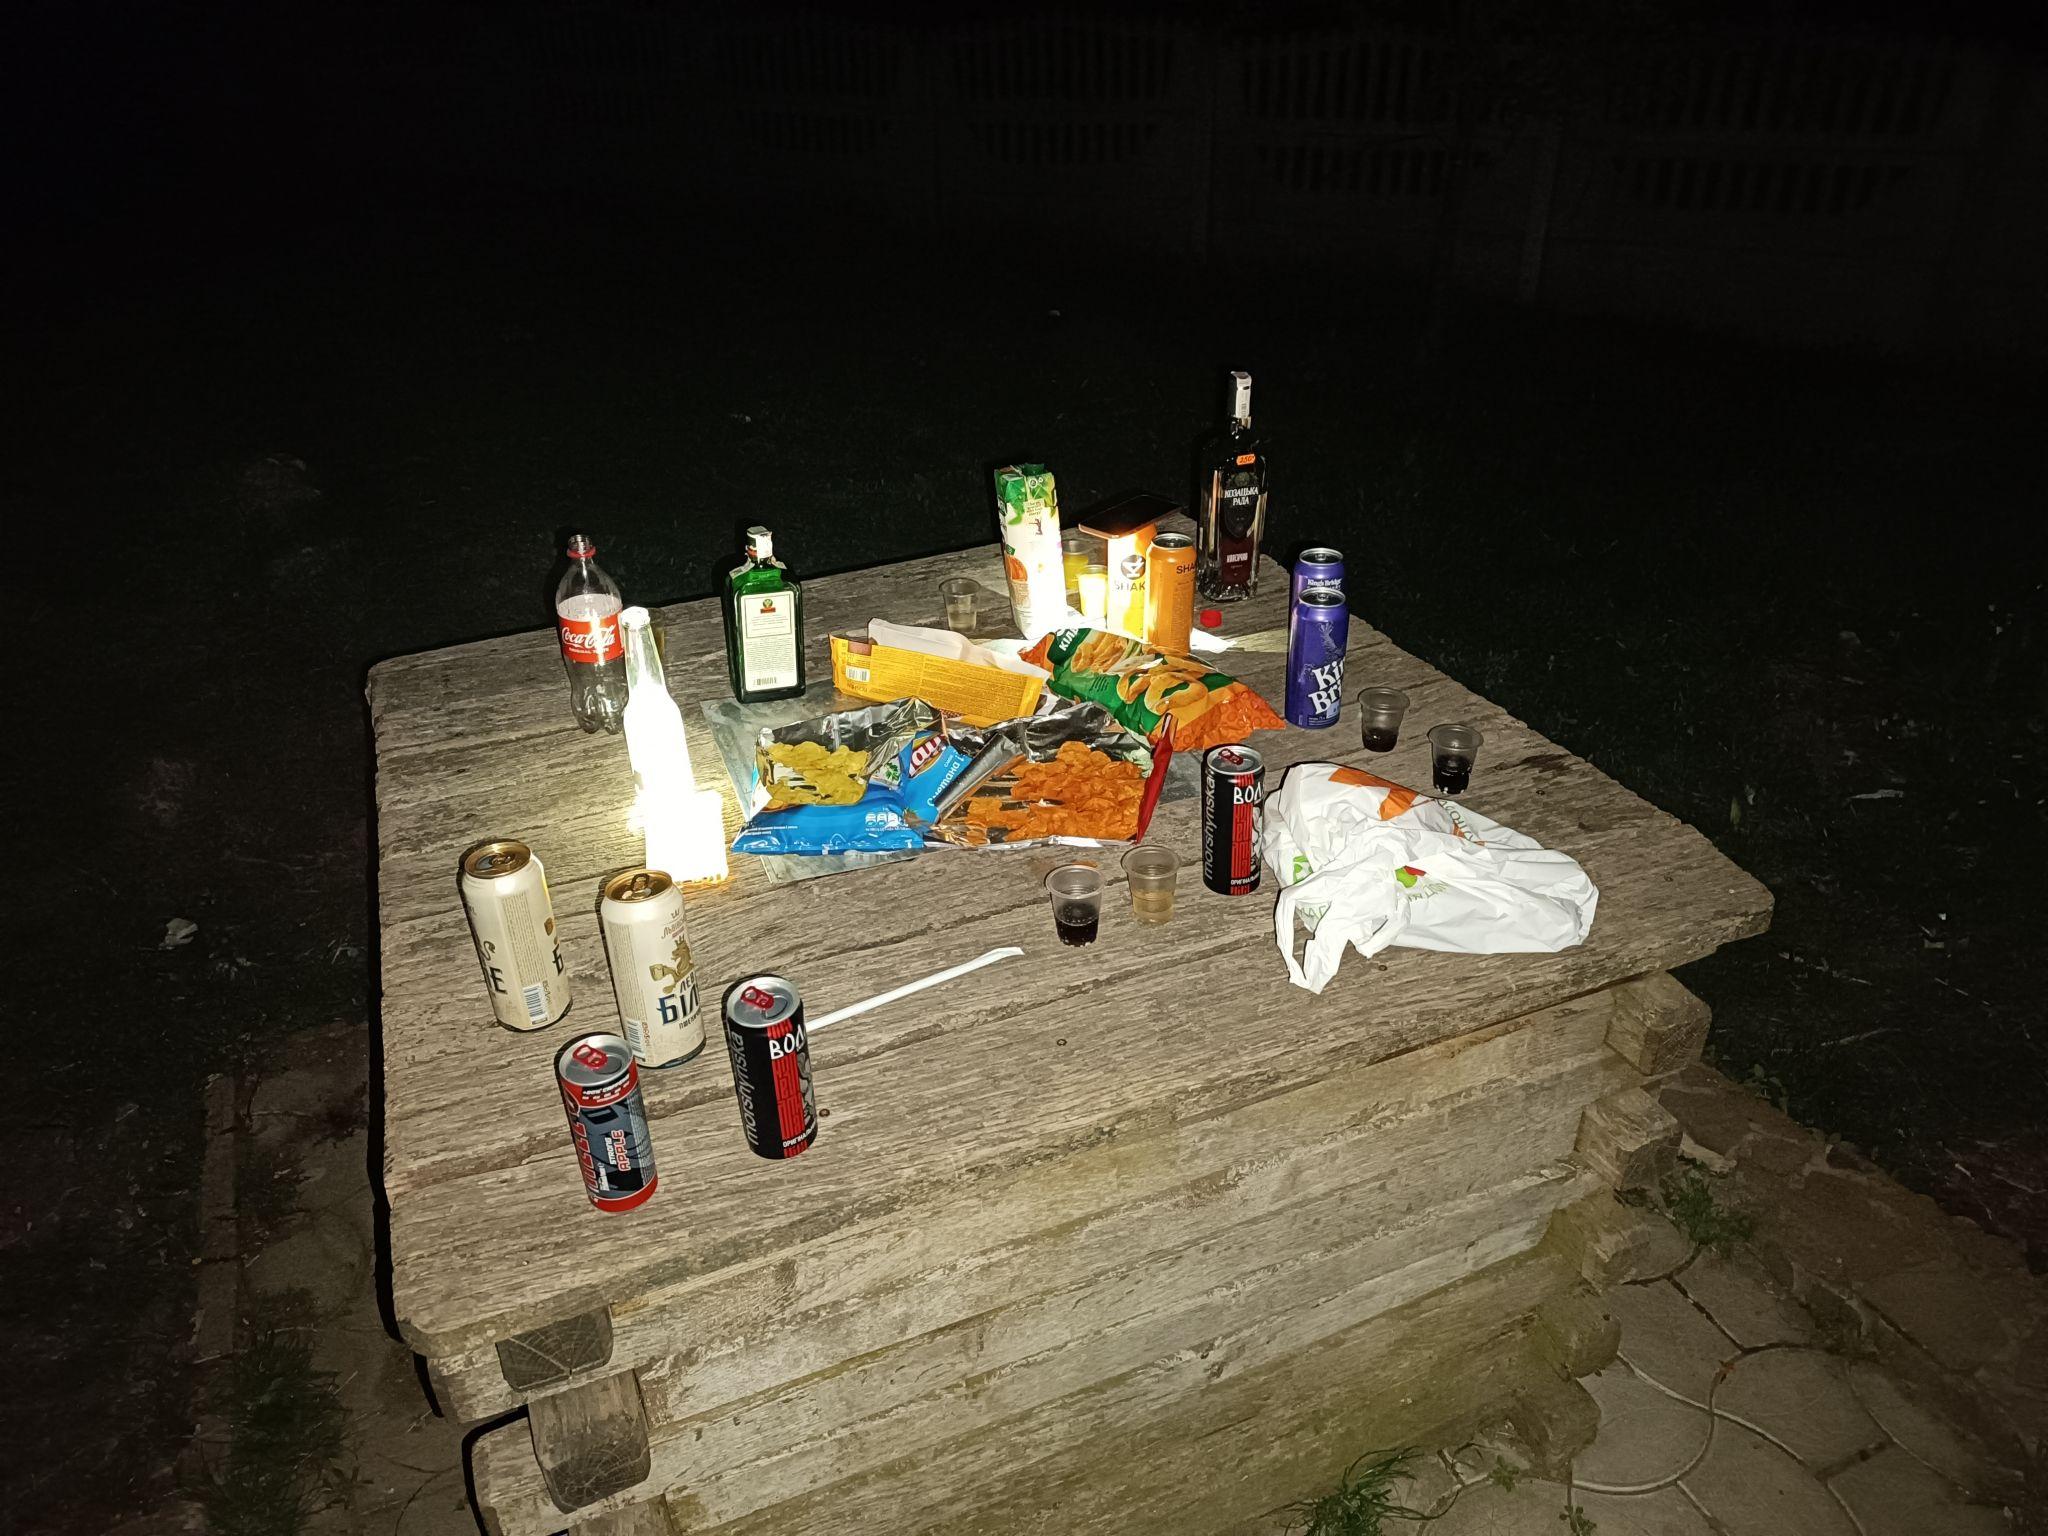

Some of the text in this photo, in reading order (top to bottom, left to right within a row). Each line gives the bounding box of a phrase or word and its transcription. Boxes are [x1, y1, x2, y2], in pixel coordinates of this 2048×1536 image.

[1224, 486, 1258, 499] КОЗАЦЬКА
[1233, 497, 1249, 506] РАДА
[1176, 562, 1195, 574] SHA
[1113, 581, 1146, 592] SHAK
[1058, 628, 1079, 651] КІЛ
[1308, 680, 1342, 714] Bri
[1204, 776, 1217, 880] morshynska
[656, 983, 699, 1026] БІЛ
[730, 1030, 759, 1146] morshynska
[604, 1137, 616, 1166] STRONG
[611, 1129, 631, 1172] APPLE
